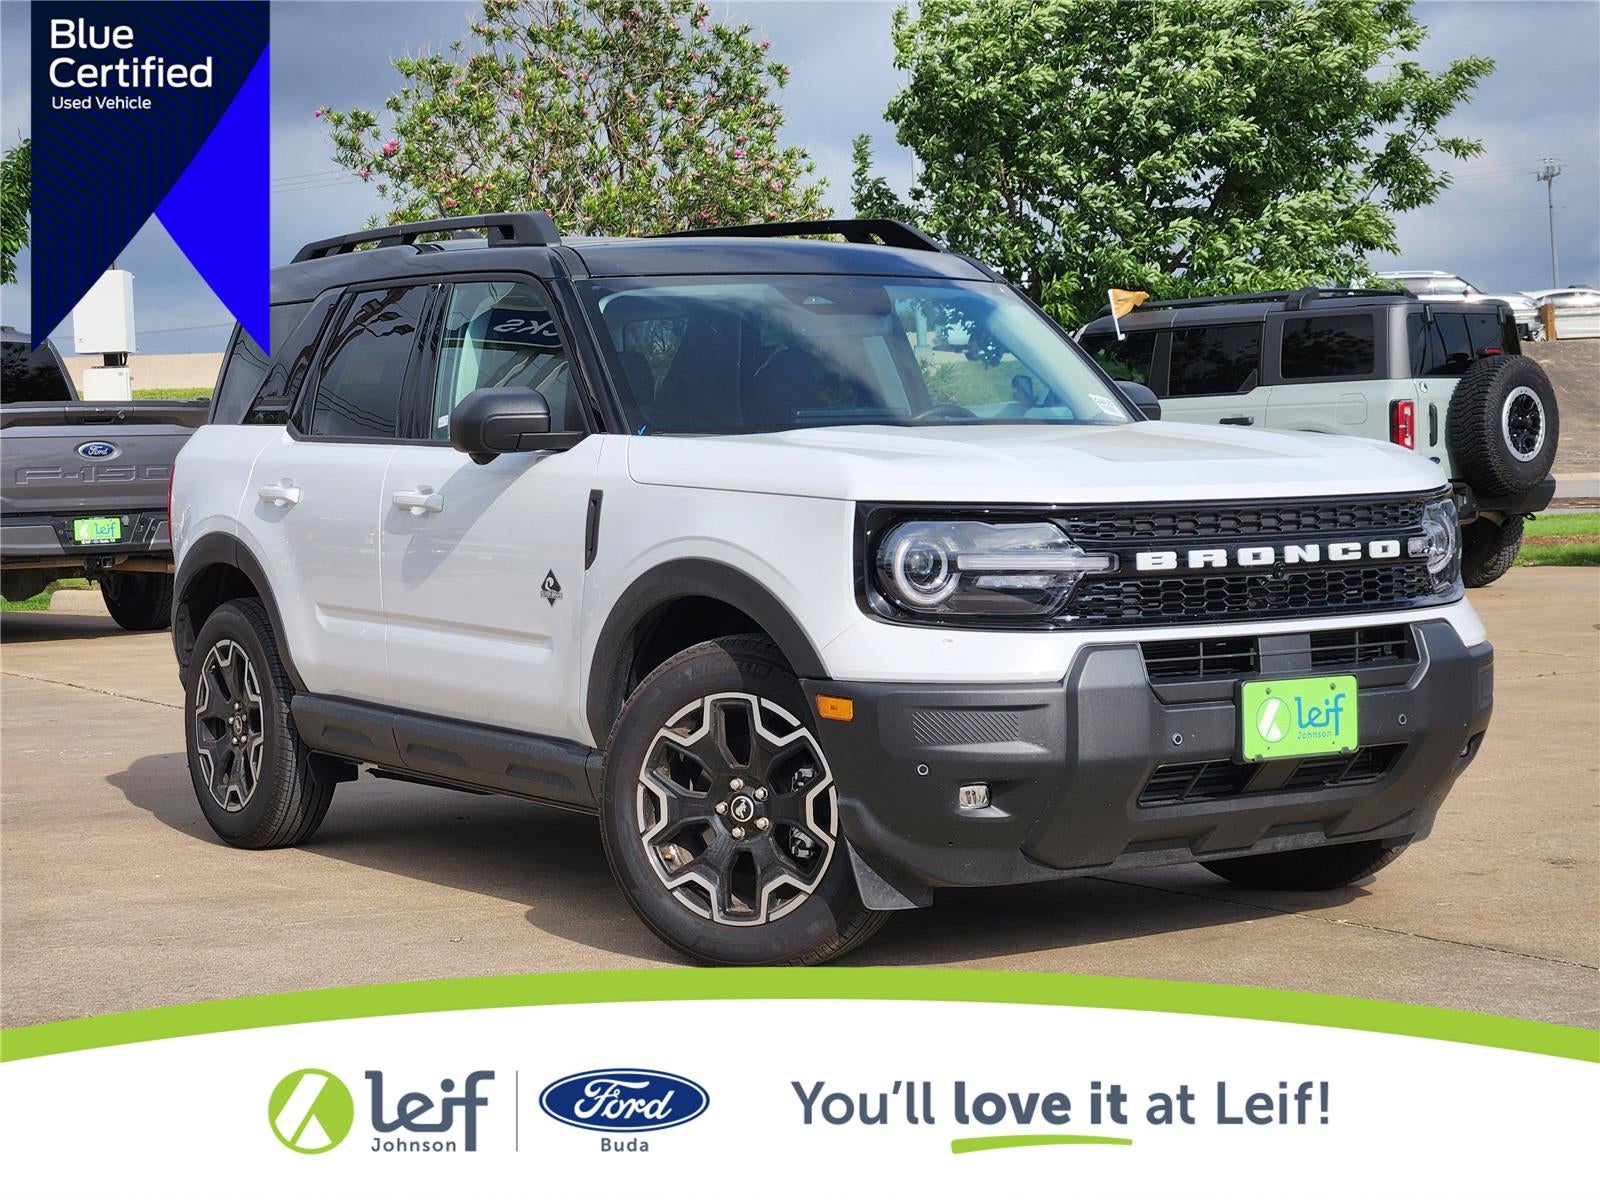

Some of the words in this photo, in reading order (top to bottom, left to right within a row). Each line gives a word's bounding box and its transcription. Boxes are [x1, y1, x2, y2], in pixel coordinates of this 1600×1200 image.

[87, 445, 109, 456] Ford
[14, 464, 171, 485] F-150
[1135, 539, 1401, 571] BRONCO
[1297, 730, 1332, 740] Johnson
